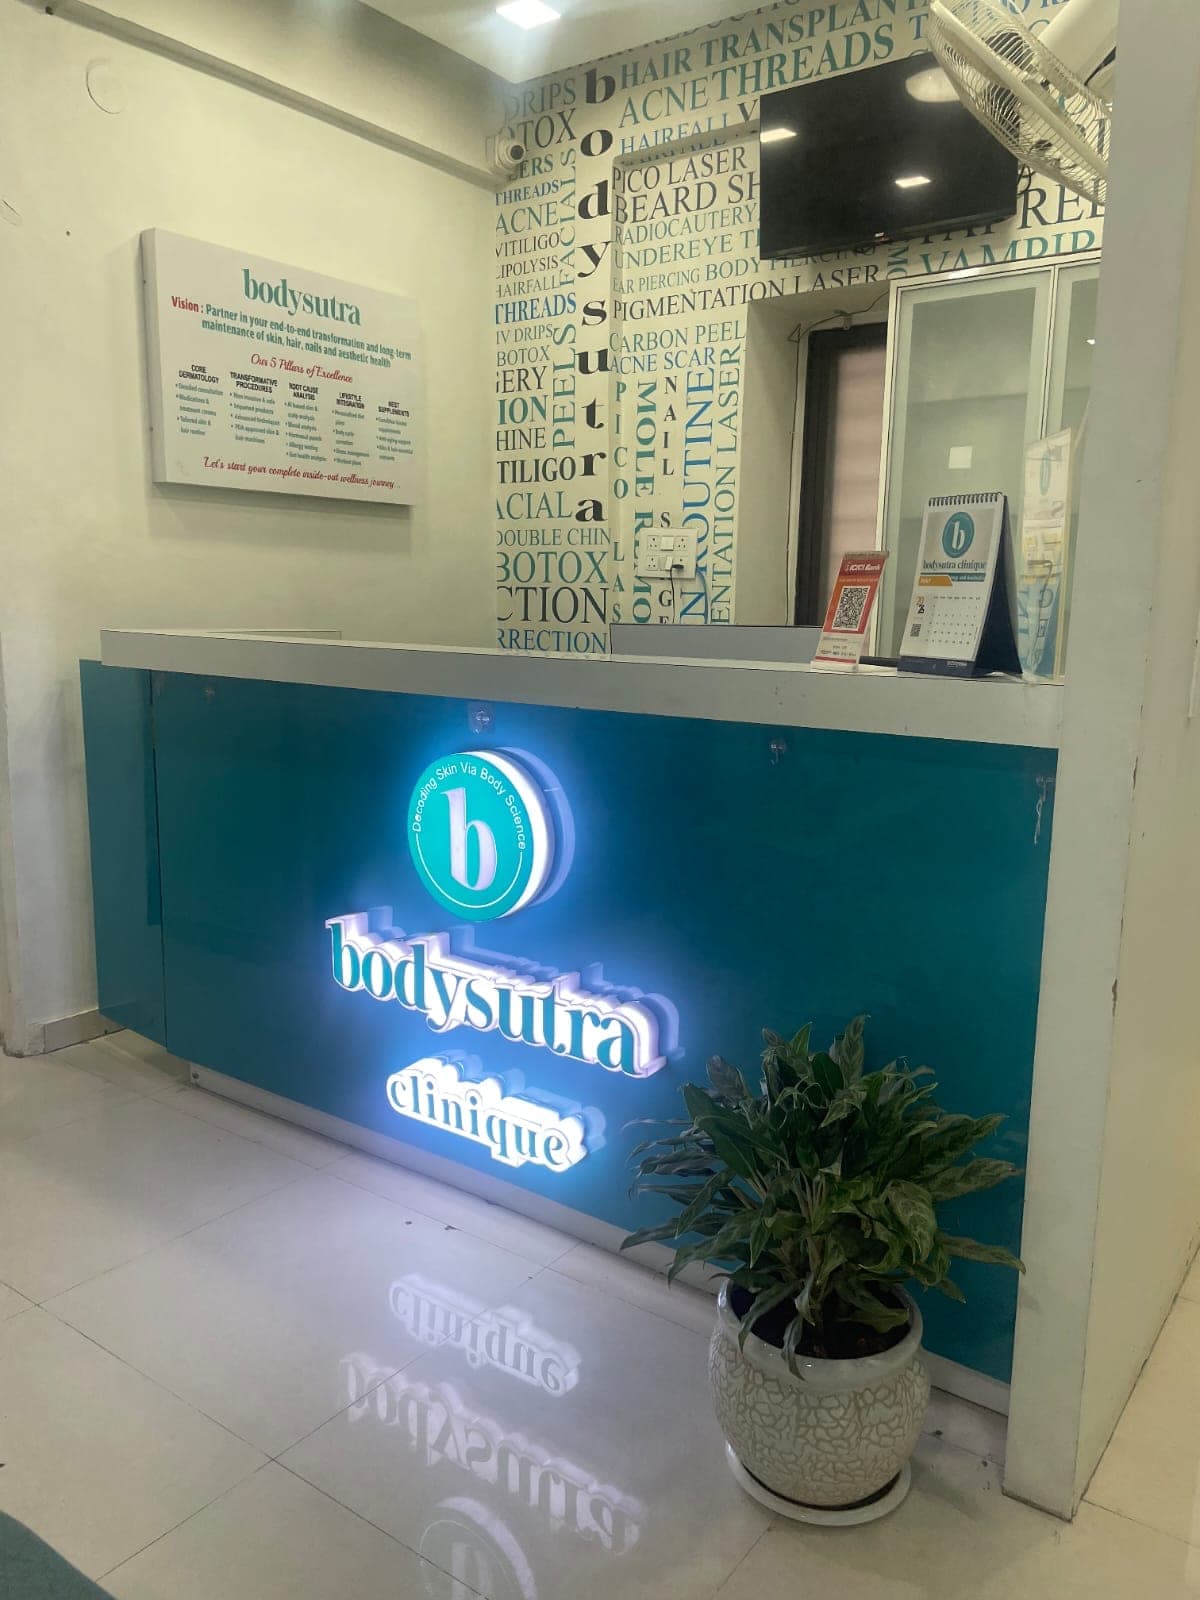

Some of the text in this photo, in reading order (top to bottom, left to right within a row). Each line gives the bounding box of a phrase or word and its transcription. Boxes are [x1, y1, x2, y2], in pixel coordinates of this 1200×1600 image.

[621, 47, 692, 90] HAIR
[701, 0, 921, 69] TRANSPLAN
[618, 76, 709, 128] ACNE
[711, 23, 894, 101] THREADS
[612, 145, 748, 195] PICO LASER
[496, 200, 559, 236] ACNE
[614, 180, 718, 225] BEARD
[614, 202, 757, 247] RADIOCAUTERY
[496, 254, 559, 280] IPOLYSIS
[614, 233, 734, 270] UNDEREYE
[613, 263, 881, 322] PIGMENTATION LASER
[638, 268, 701, 293] PIERCING
[705, 256, 760, 282] BODY
[242, 268, 361, 326] bodysutra
[171, 295, 199, 313] Vision
[205, 303, 239, 321] Partner
[240, 311, 248, 323] in
[249, 315, 268, 328] your
[269, 319, 311, 338] end-to-end
[312, 329, 365, 350] transformation
[366, 341, 379, 354] and
[379, 344, 412, 361] long-term
[202, 319, 255, 340] maintenance
[256, 330, 265, 341] of
[305, 341, 322, 353] nails
[323, 346, 337, 358] and
[514, 323, 553, 343] DRIPS
[609, 319, 747, 353] CARBON PEEL
[250, 353, 268, 368] Our
[279, 358, 305, 375] Pillars
[315, 366, 353, 384] Excellence
[496, 344, 551, 367] BOTOX
[609, 346, 717, 375] ACNE SCAR
[496, 365, 548, 394] ERY
[497, 394, 549, 425] ION
[203, 456, 224, 469] Let's
[496, 456, 577, 484] TILIGO
[566, 527, 611, 546] CHIN
[411, 761, 527, 851] Decoding Skin Via Body Science
[440, 786, 498, 892] b
[326, 920, 642, 1077] bodysutra
[389, 1072, 566, 1168] clinique
